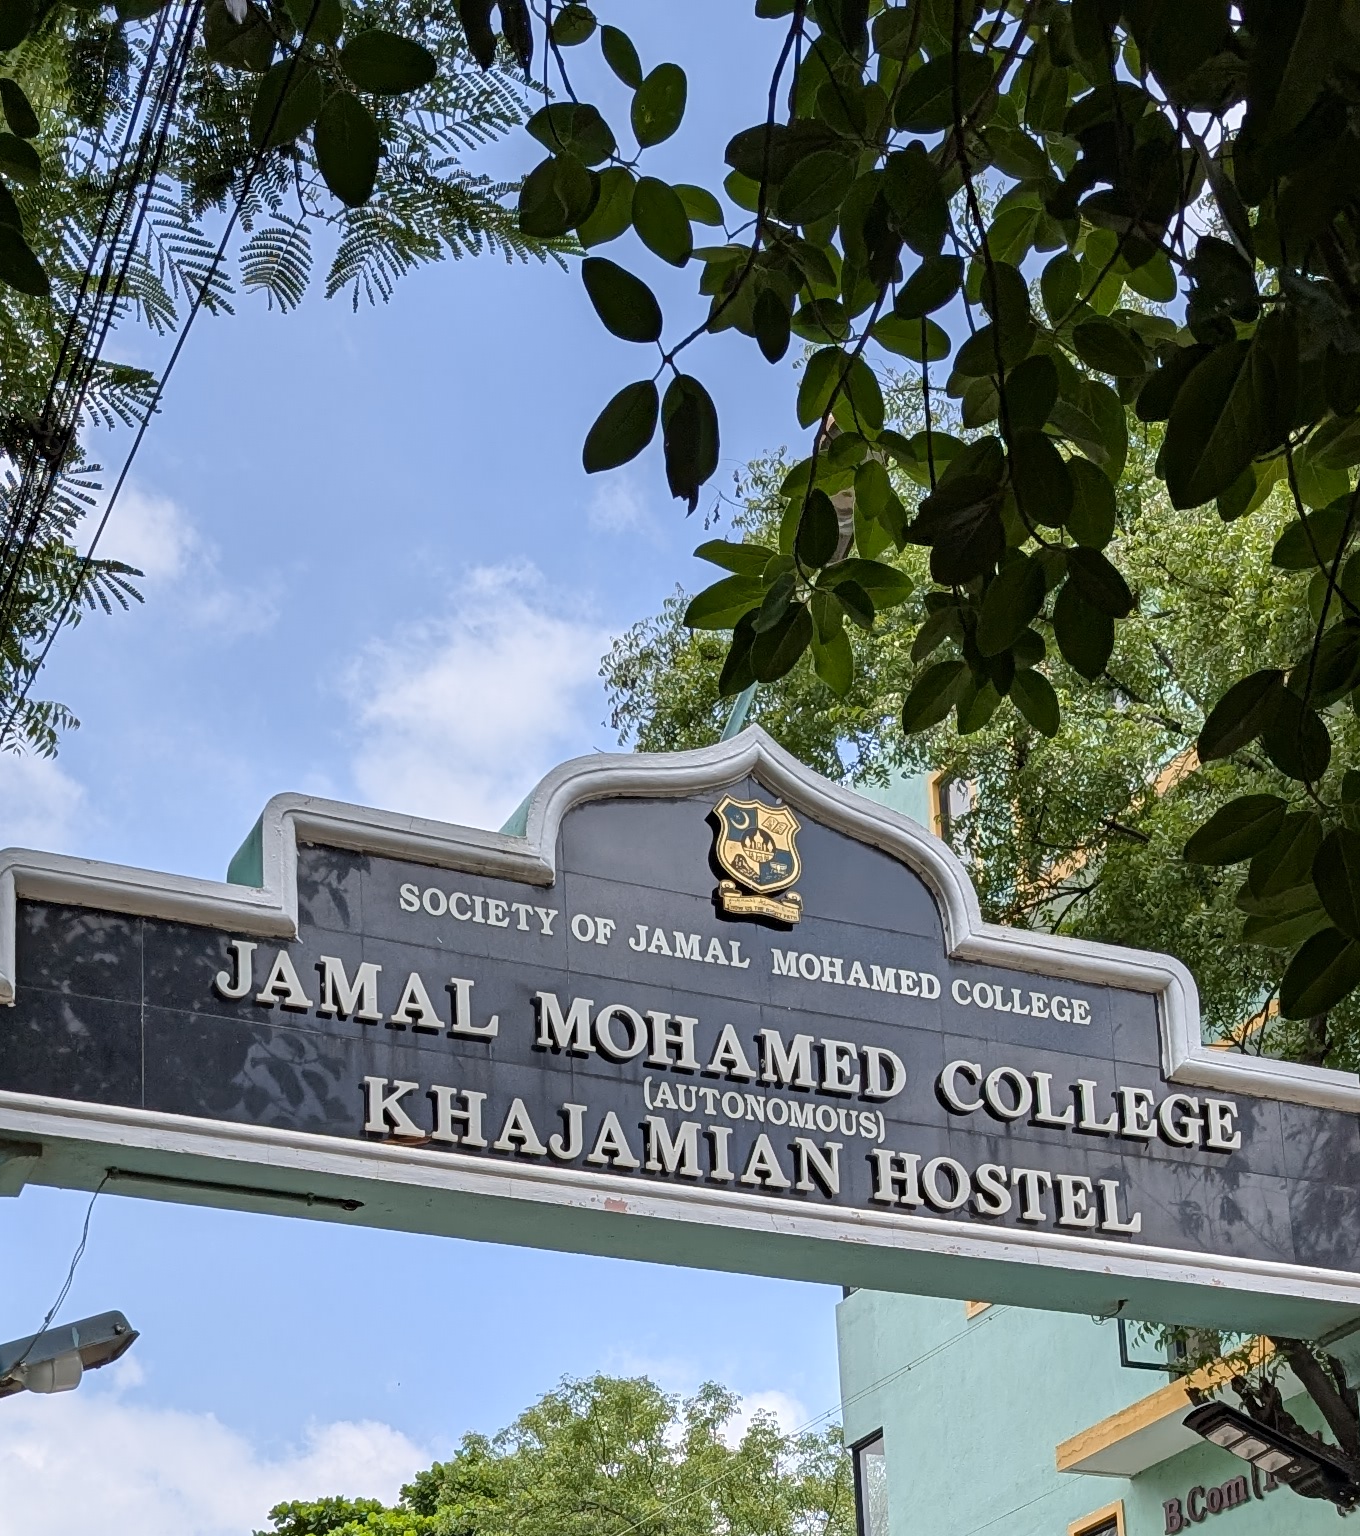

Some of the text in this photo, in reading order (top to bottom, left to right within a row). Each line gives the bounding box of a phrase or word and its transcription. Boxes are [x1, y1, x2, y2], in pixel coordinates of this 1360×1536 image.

[399, 884, 1092, 1025] SOCIETY OF JAMAL MOHAMED COLLEGE
[216, 940, 1241, 1150] JAMAL MOHAMED COLLEGE
[644, 1076, 885, 1144] (AUTONOMOUS)
[363, 1076, 1141, 1233] KHAJAMIAN HOSTEL
